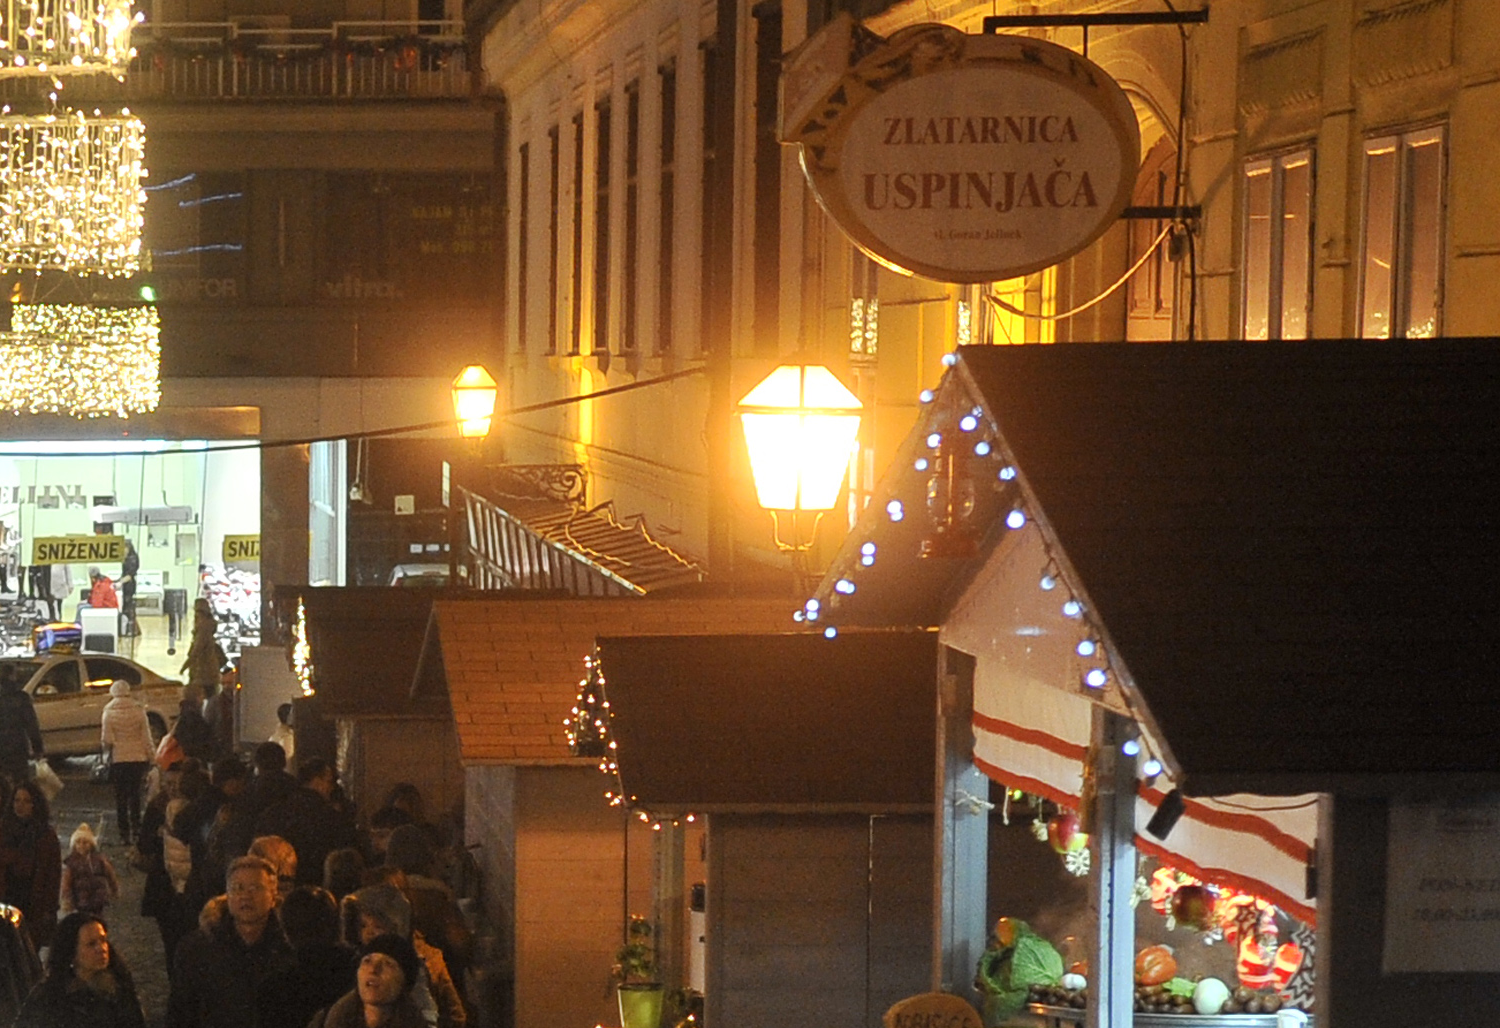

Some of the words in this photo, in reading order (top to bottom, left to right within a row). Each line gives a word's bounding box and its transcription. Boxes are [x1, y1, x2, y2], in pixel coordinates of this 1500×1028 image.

[883, 115, 1078, 146] ZLATARNICA
[863, 158, 1097, 213] USPINJAČA
[38, 539, 120, 561] SNIŽENJE
